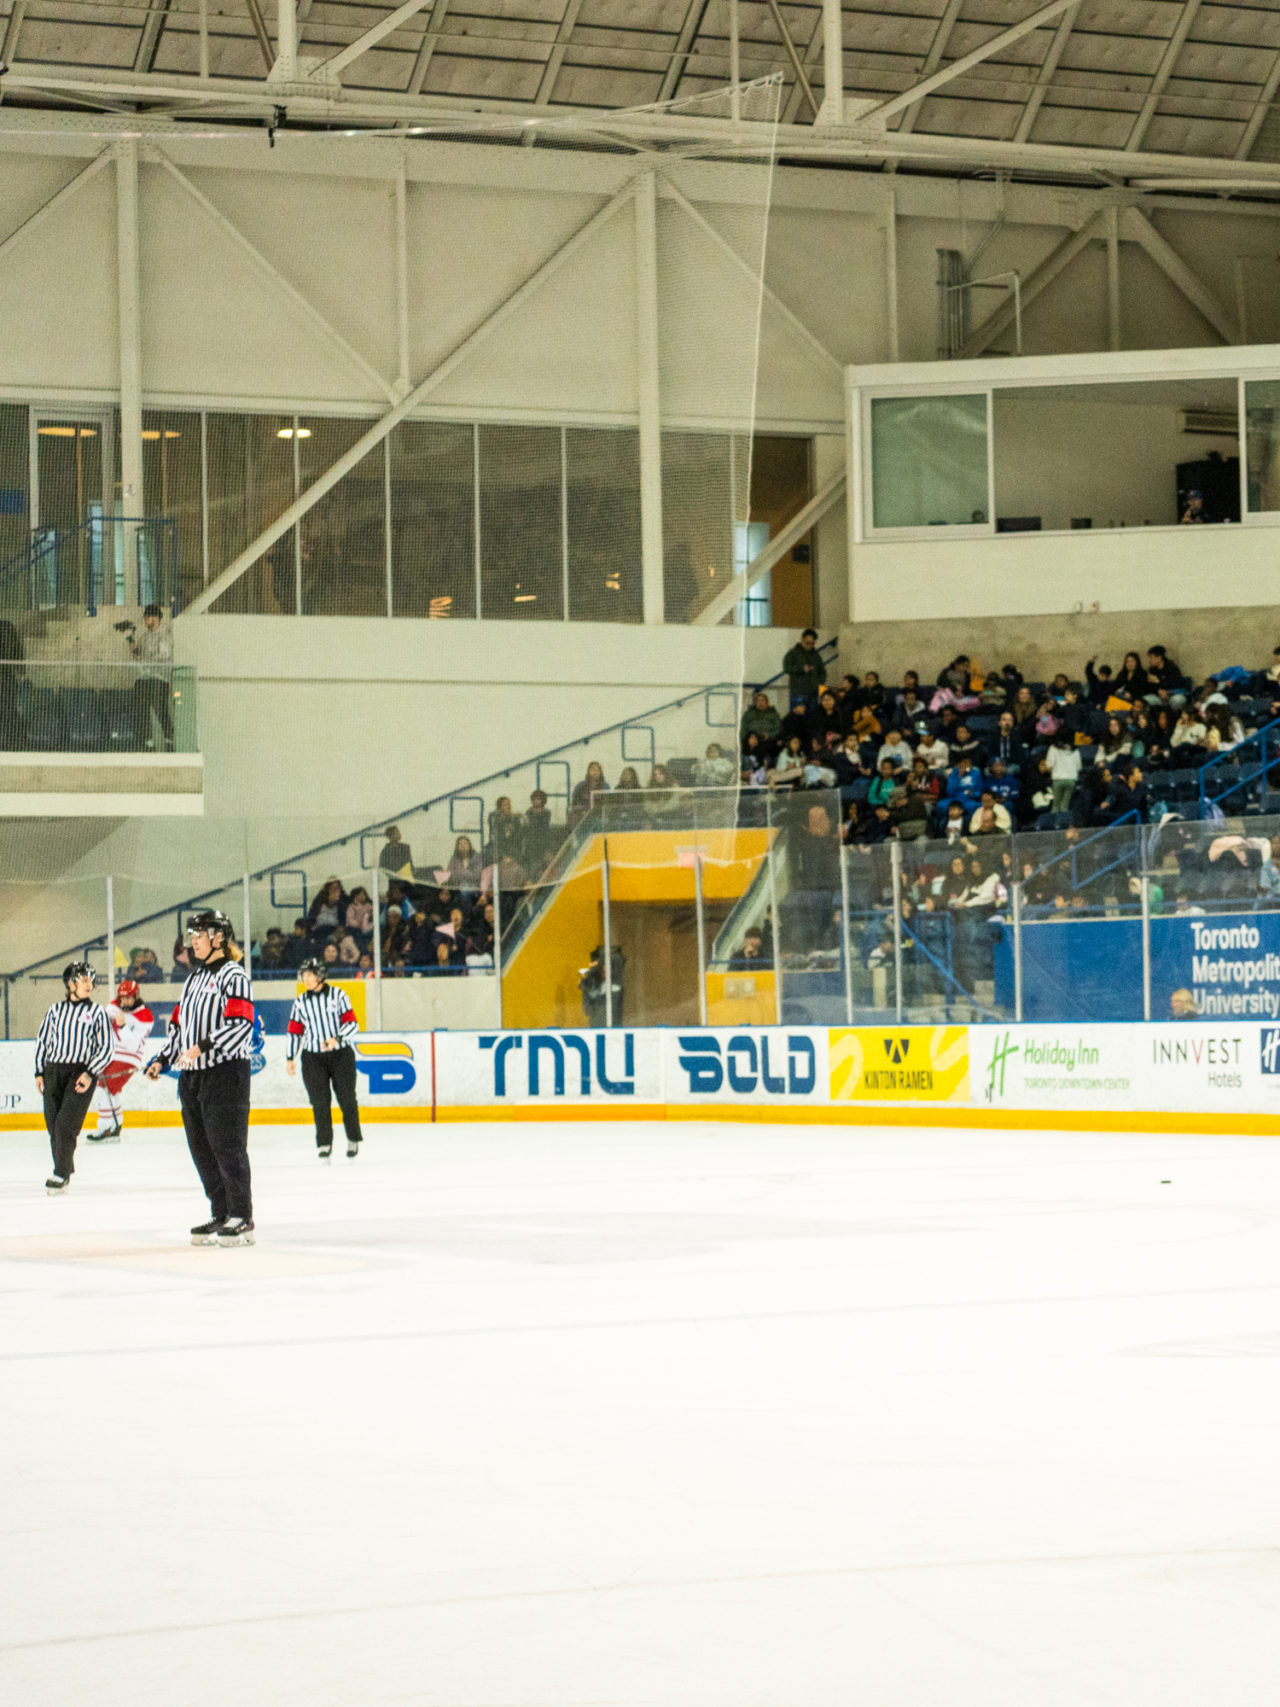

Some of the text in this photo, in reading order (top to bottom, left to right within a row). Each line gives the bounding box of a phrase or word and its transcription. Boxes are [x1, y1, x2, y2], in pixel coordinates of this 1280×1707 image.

[1190, 922, 1260, 950] Toronto
[1192, 986, 1280, 1019] University
[478, 1033, 634, 1096] TMU
[678, 1035, 816, 1094] BOLD
[1024, 1038, 1099, 1071] Holiday Inn
[1153, 1038, 1242, 1066] INNVEST
[864, 1070, 933, 1091] KINTON RAMEN
[1208, 1072, 1242, 1088] Hotels
